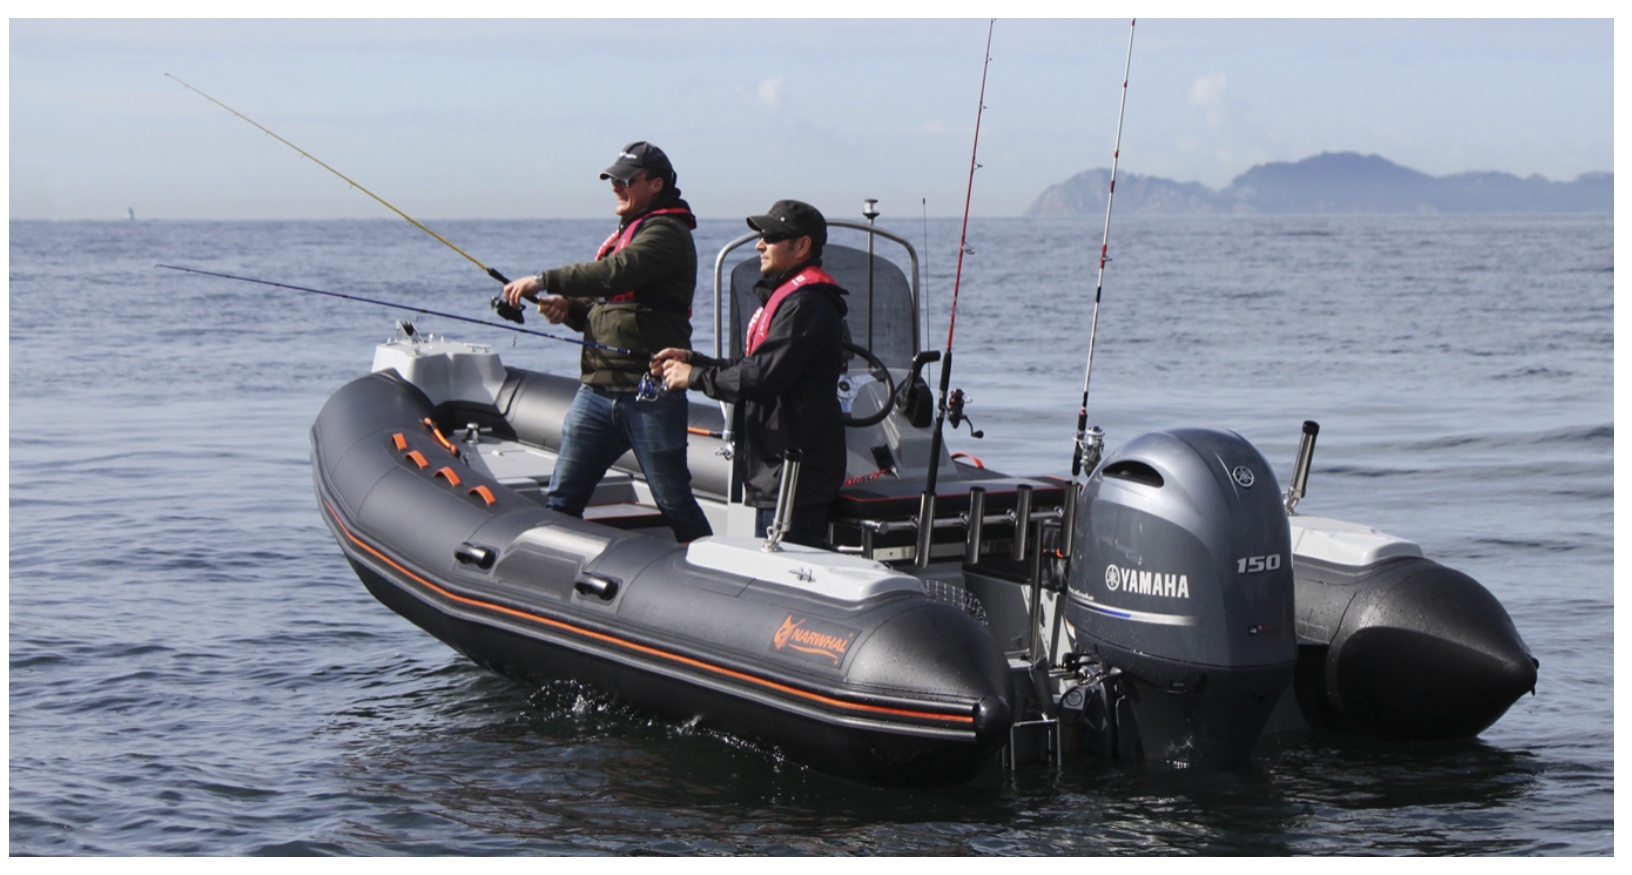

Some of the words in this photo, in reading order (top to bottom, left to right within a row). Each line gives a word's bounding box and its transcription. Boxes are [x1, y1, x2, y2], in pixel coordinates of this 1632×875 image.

[1237, 553, 1281, 574] 150
[1120, 567, 1190, 599] YAMAHA
[790, 628, 848, 653] NARWHAL
